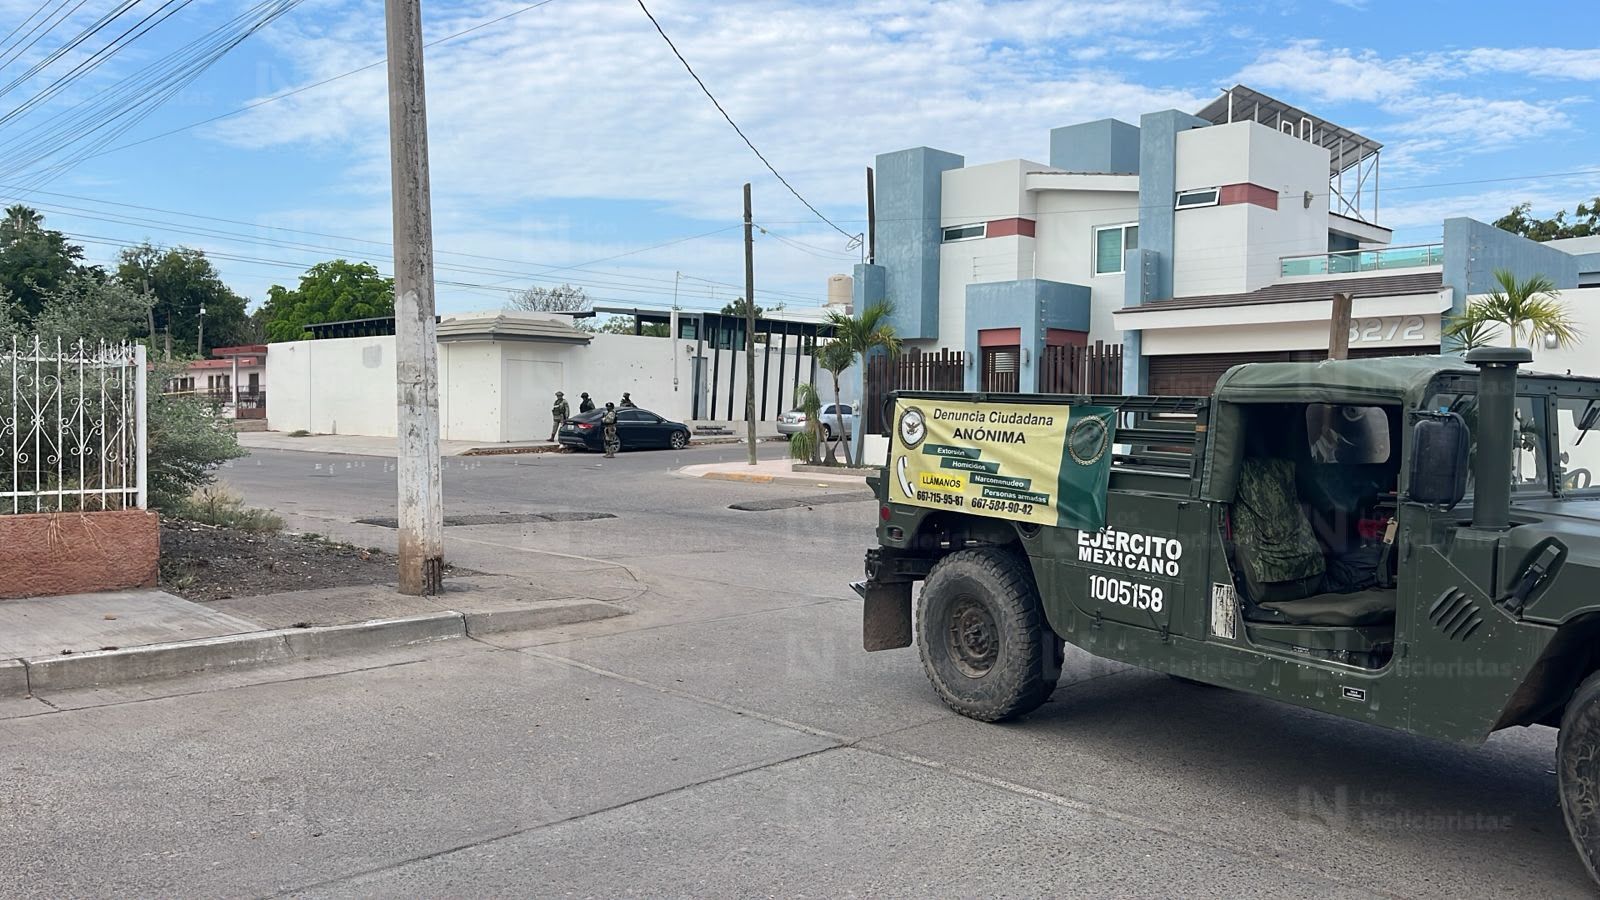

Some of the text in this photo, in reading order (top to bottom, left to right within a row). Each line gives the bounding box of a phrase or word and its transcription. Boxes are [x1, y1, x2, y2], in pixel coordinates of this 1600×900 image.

[934, 409, 1053, 425] Denuncia Ciudadana
[953, 427, 1025, 444] ANÓNIMA
[937, 447, 965, 456] Extorsión
[952, 460, 986, 470] Homicidios
[922, 475, 961, 488] LLÁMANOS
[975, 475, 1024, 487] Narcomenudeo
[916, 490, 1033, 515] 667-715-95-87 667-584-90-42
[984, 486, 1047, 503] Personas armadas
[1077, 526, 1183, 561] EJÉRCITO
[1078, 546, 1180, 577] MEXICANO
[1089, 575, 1164, 612] 1005158
